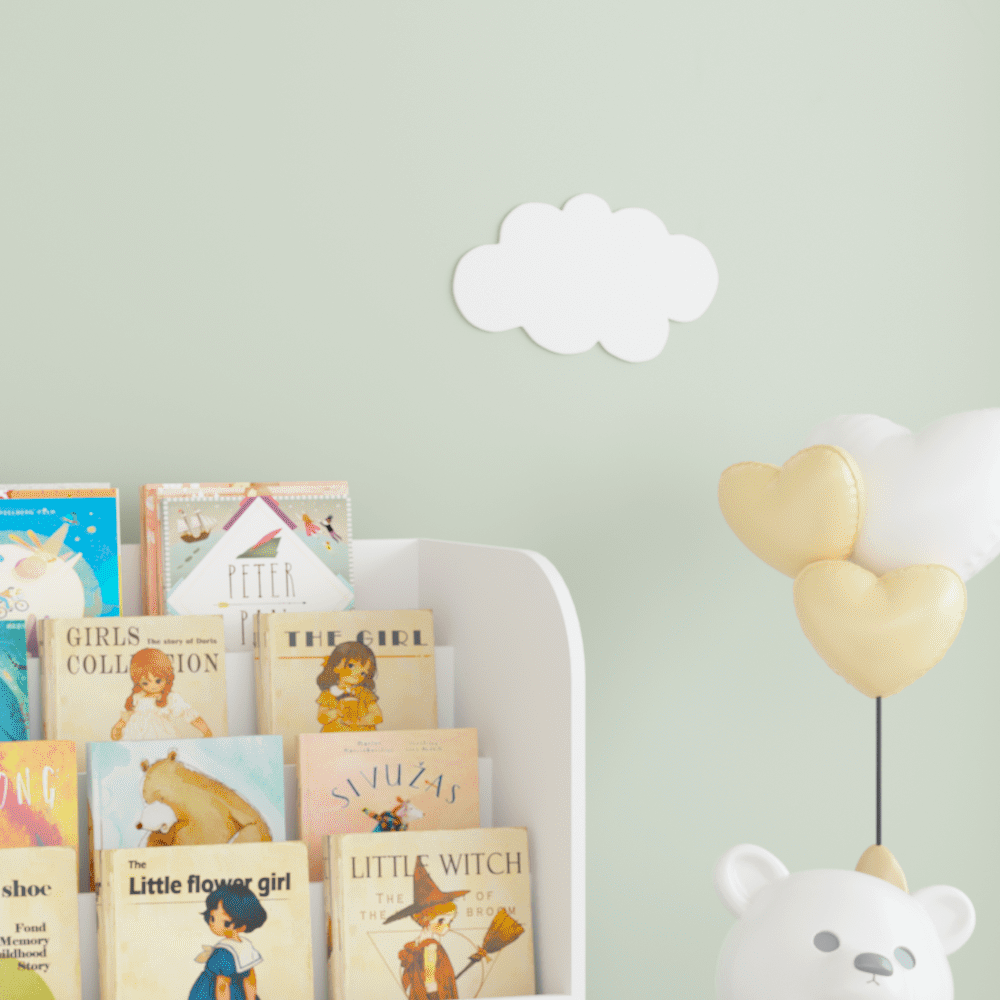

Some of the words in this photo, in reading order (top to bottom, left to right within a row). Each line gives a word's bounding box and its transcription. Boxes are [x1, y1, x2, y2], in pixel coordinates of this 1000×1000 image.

[228, 562, 296, 599] PETER
[67, 626, 140, 647] GIRLS
[284, 630, 342, 647] THE
[356, 629, 428, 647] GIRL
[67, 653, 219, 675] COLLION
[128, 860, 147, 869] The
[439, 852, 522, 876] WITCH
[2, 879, 52, 898] shoe
[129, 876, 181, 895] Little
[187, 874, 252, 894] flower
[258, 872, 291, 897] girl
[376, 892, 404, 904] THE
[475, 891, 493, 902] OF
[360, 910, 387, 920] THE
[15, 922, 47, 933] Fond
[0, 935, 50, 948] Memory
[17, 960, 50, 972] Story
